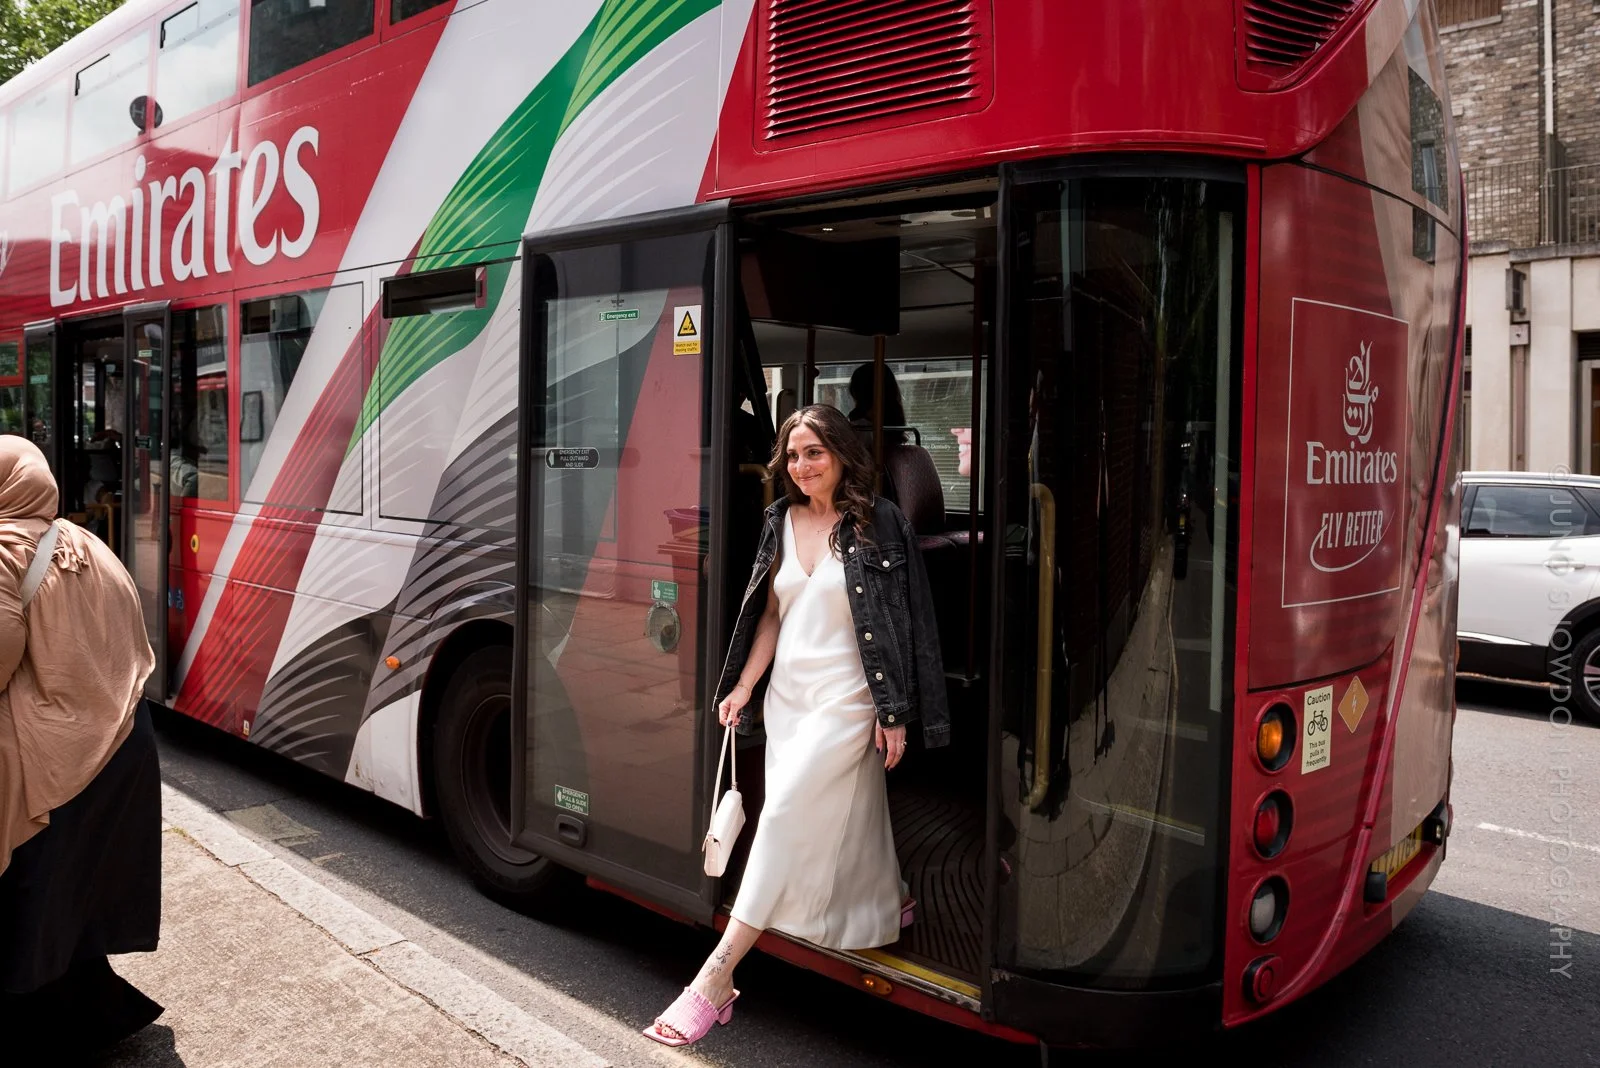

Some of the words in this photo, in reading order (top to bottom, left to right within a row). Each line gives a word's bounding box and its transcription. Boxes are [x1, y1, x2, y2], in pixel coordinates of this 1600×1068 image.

[50, 126, 320, 307] Emirates
[1306, 441, 1397, 485] Emirates
[1319, 512, 1343, 549] FLY
[1344, 510, 1383, 547] BETTER
[1307, 692, 1331, 706] Caution
[1310, 750, 1319, 758] pulls
[1306, 756, 1327, 767] frequently
[561, 794, 571, 803] PULL
[576, 799, 586, 807] SLIDE
[562, 788, 586, 800] EMERGENCY
[572, 804, 584, 812] OPEN
